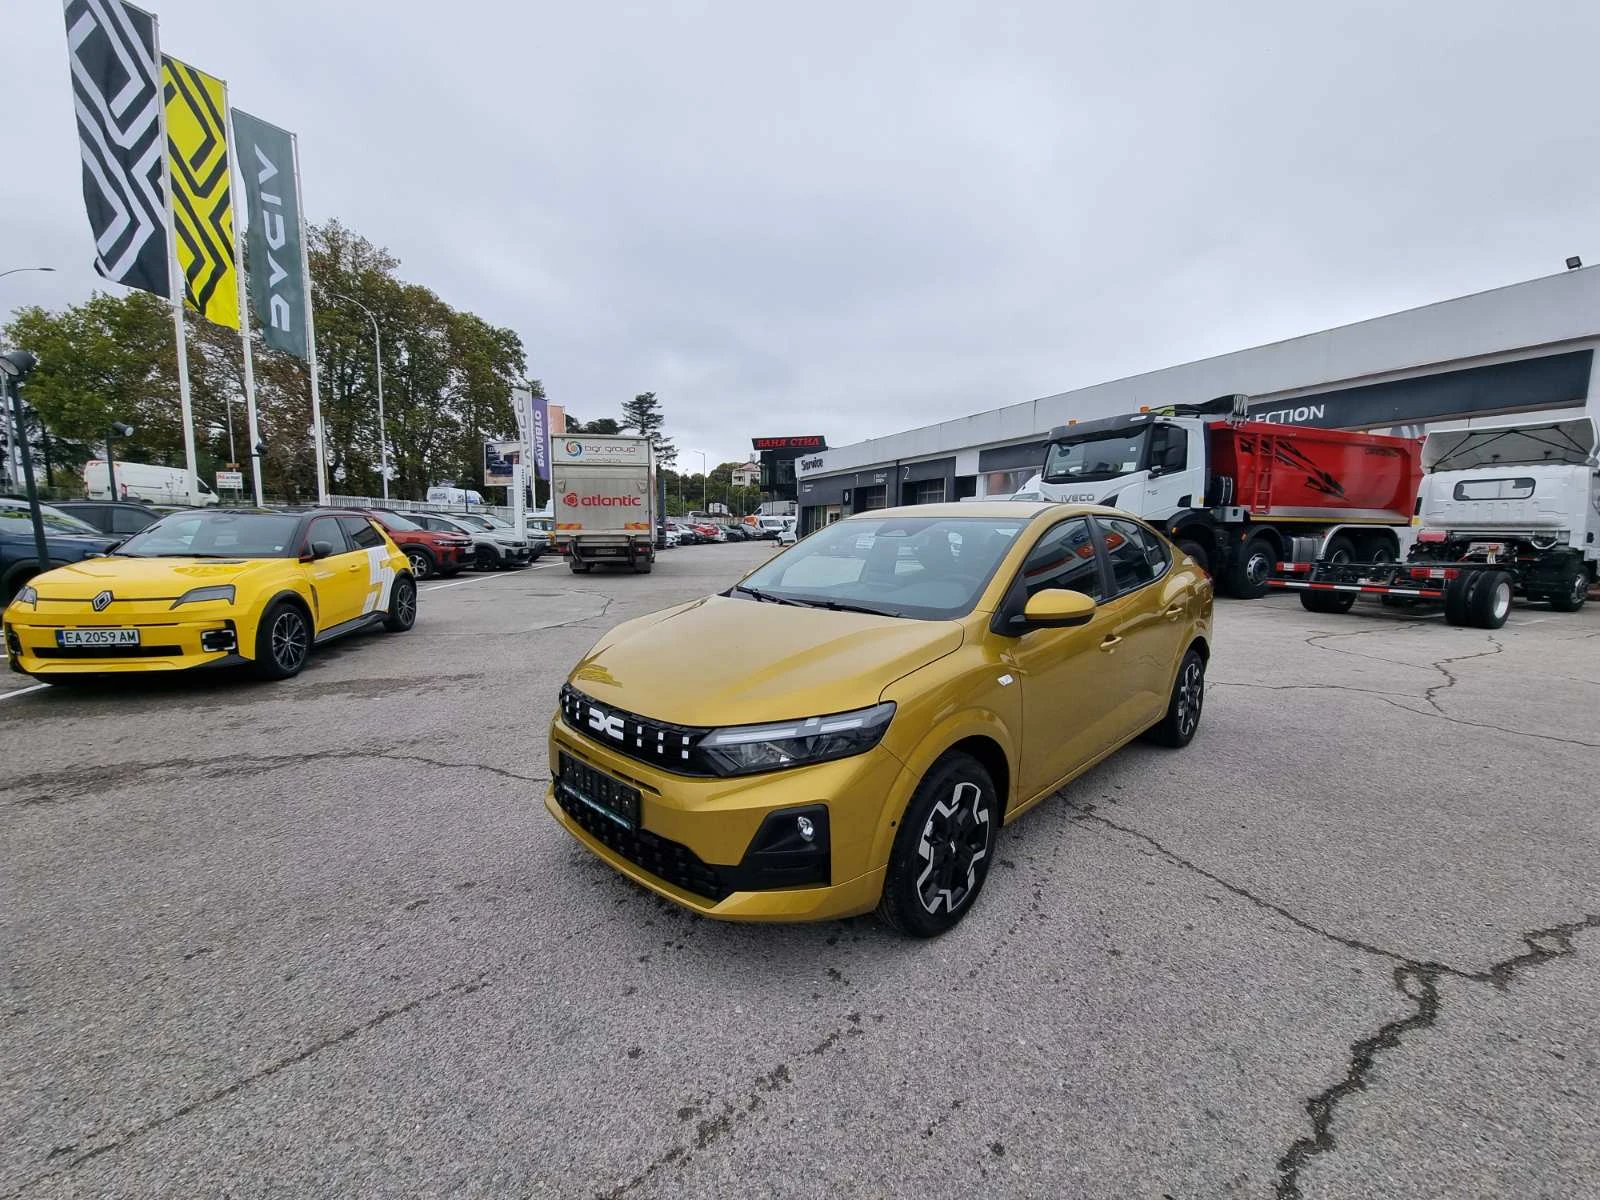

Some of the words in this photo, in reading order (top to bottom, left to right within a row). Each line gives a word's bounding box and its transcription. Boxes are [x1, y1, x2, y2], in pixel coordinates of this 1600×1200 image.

[1246, 404, 1325, 425] ECTION
[801, 456, 824, 471] Service
[903, 466, 910, 480] 2
[581, 494, 641, 507] atlantic
[1061, 494, 1095, 503] IVECO
[65, 631, 83, 644] EA
[84, 631, 116, 643] 2059
[120, 631, 137, 642] AM
